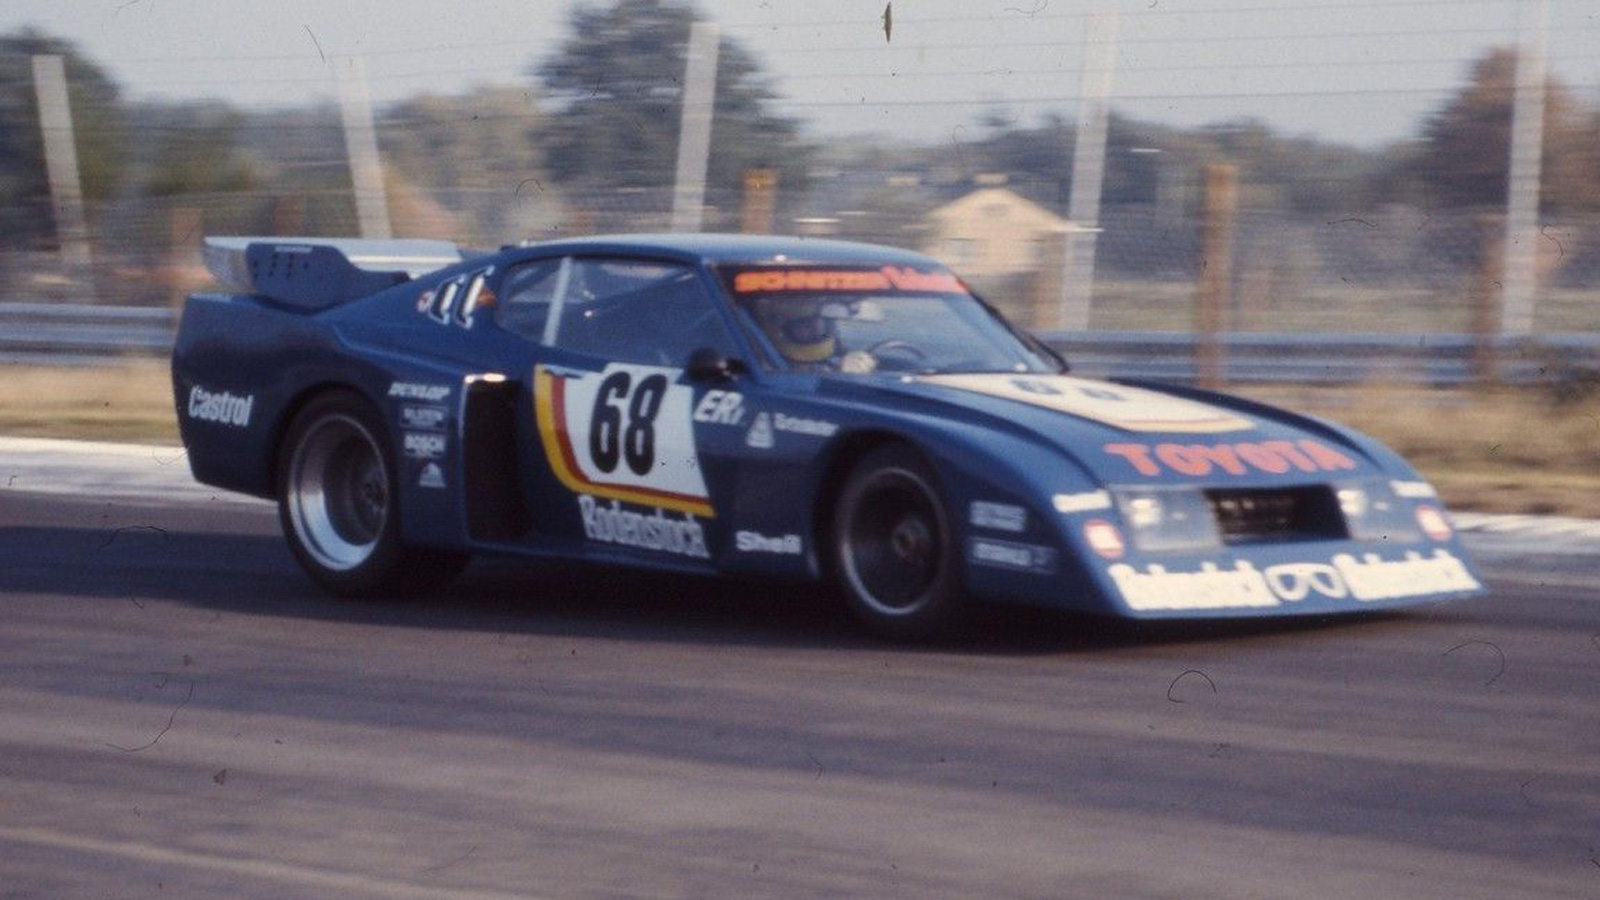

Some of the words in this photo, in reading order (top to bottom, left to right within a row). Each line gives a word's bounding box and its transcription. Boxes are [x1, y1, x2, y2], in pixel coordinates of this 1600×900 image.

[188, 384, 254, 427] Castrol
[590, 371, 668, 476] 68
[1103, 439, 1356, 477] TOYOTA
[736, 530, 802, 554] Shell
